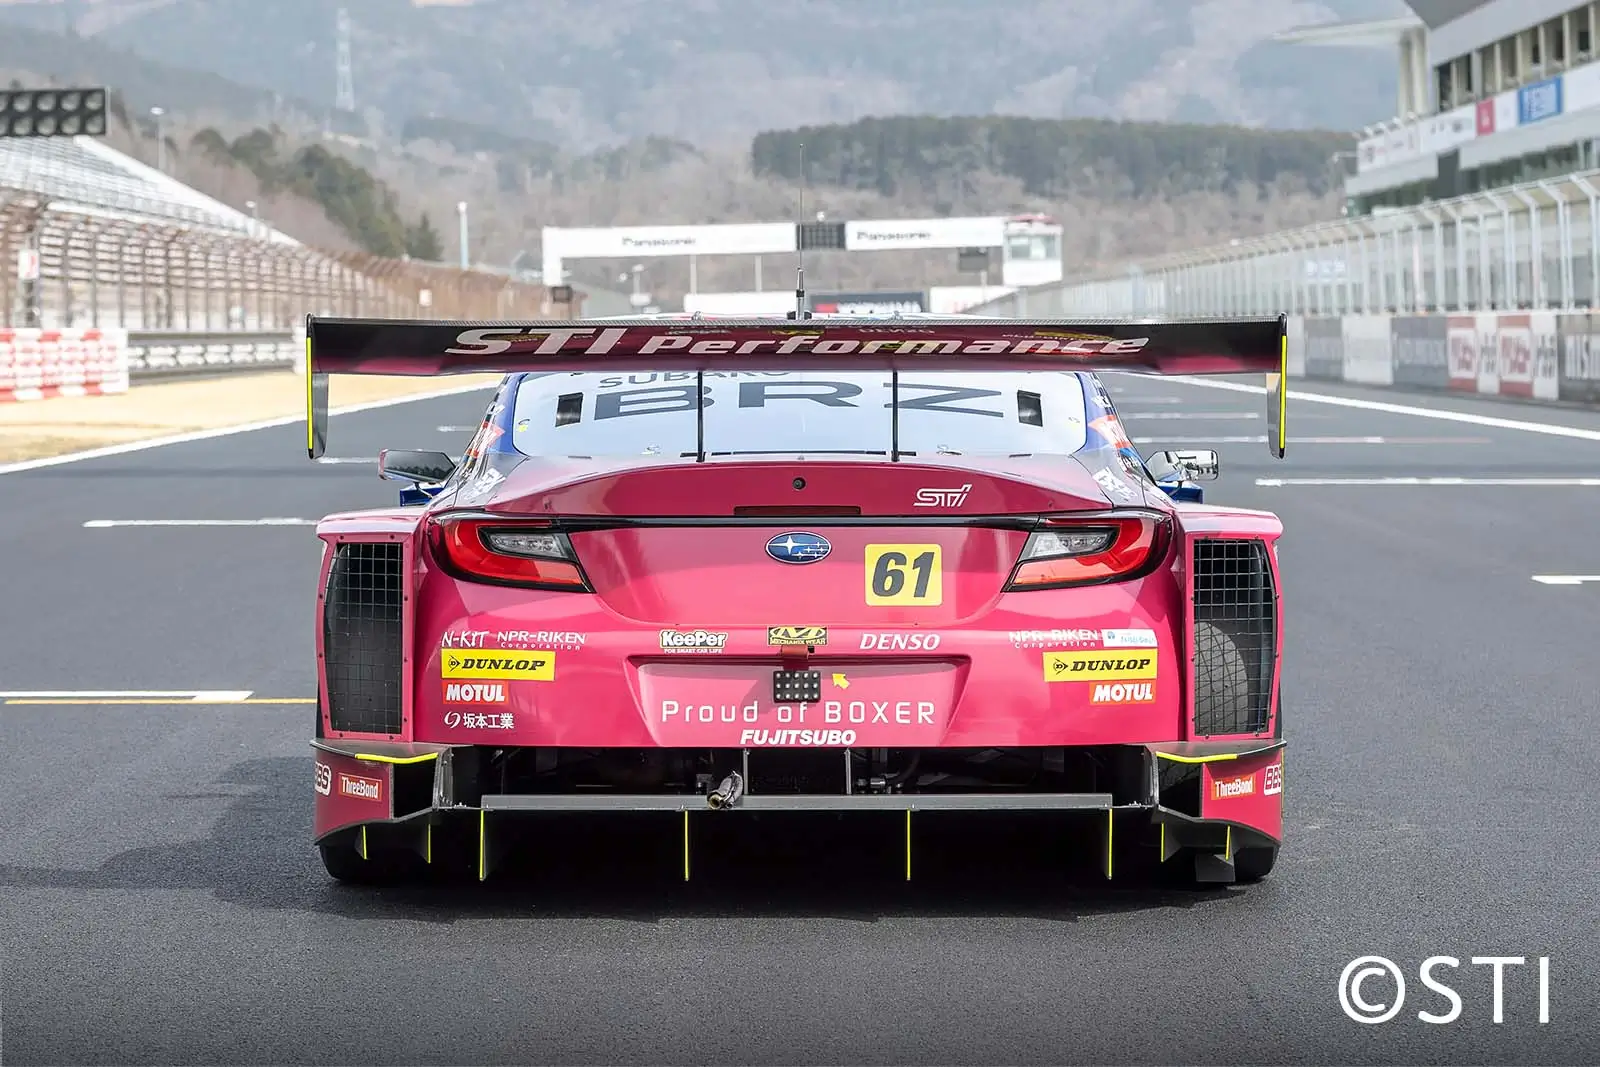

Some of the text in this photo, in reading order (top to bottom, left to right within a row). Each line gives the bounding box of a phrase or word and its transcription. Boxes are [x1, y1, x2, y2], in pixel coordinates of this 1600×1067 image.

[444, 328, 1150, 355] STI Performance
[593, 381, 1005, 421] BRZ
[872, 552, 935, 598] 61
[497, 631, 587, 645] NPR-RIKEN
[661, 631, 727, 648] KeePer
[859, 633, 941, 651] DENSO
[1008, 630, 1099, 642] NPR-RIKEN
[500, 641, 582, 651] Corporation
[1014, 641, 1096, 649] Corporation
[461, 658, 545, 671] DUNLOP
[1070, 658, 1151, 672] DUNLOP
[446, 684, 505, 702] MOTUL
[1093, 683, 1153, 702] MOTUL
[463, 712, 514, 729] 坂本工業
[661, 700, 935, 724] Proud of BOXER
[739, 729, 857, 746] FUJITSUBO
[341, 776, 379, 799] ThreeBond
[1215, 776, 1254, 798] ThreeBond
